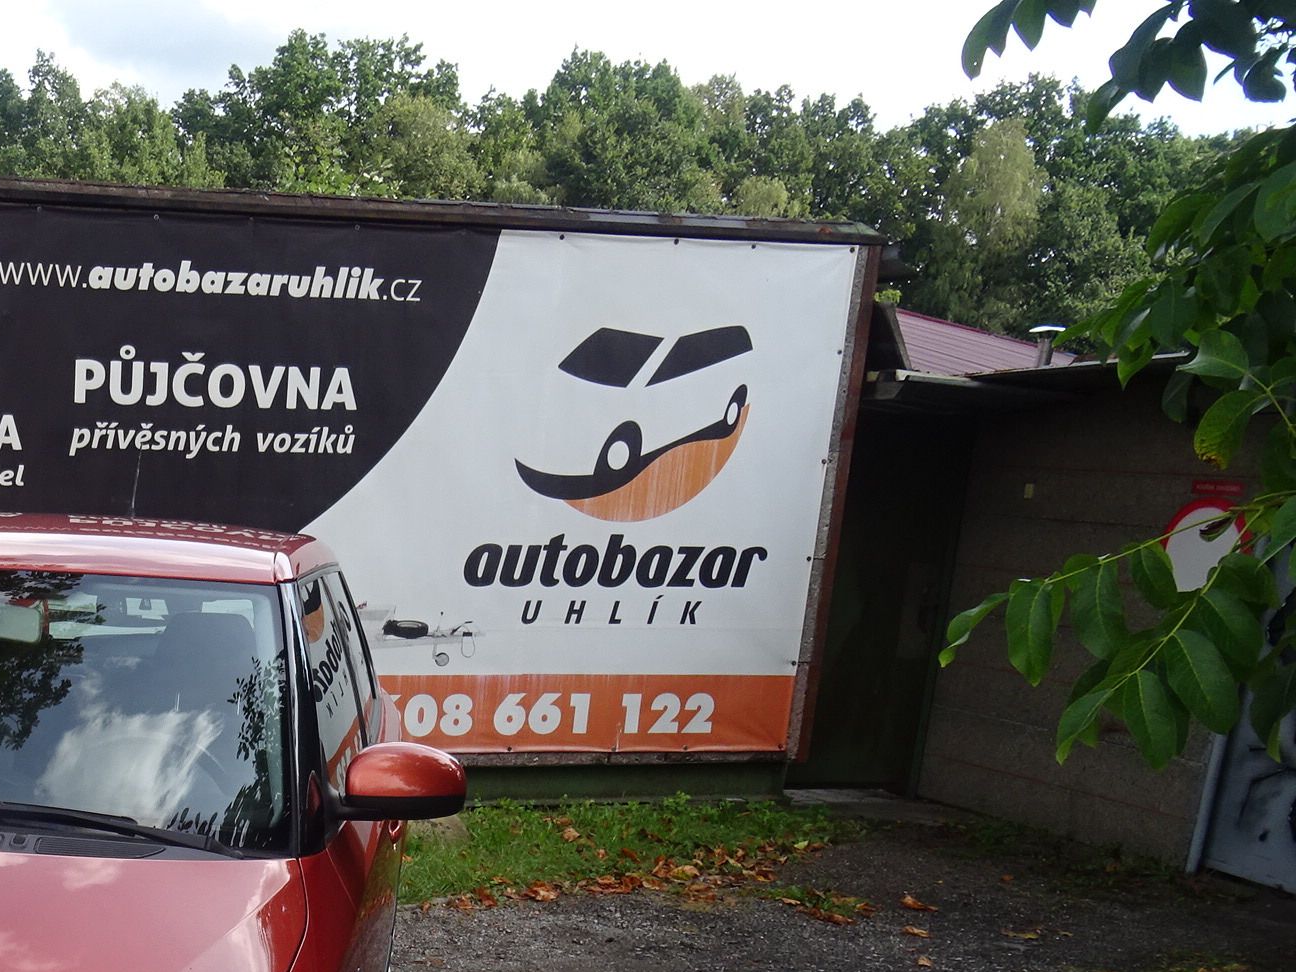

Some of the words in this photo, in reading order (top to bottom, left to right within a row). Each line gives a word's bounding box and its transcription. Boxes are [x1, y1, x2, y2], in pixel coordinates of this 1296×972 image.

[73, 344, 358, 411] PŮJČOVNA
[69, 421, 241, 460] přívěsných
[256, 424, 356, 455] vozíků
[462, 533, 768, 589] autobazar
[520, 594, 705, 625] UHLÍK
[389, 693, 473, 737] 08
[493, 692, 591, 736] 661
[621, 692, 713, 735] 122
